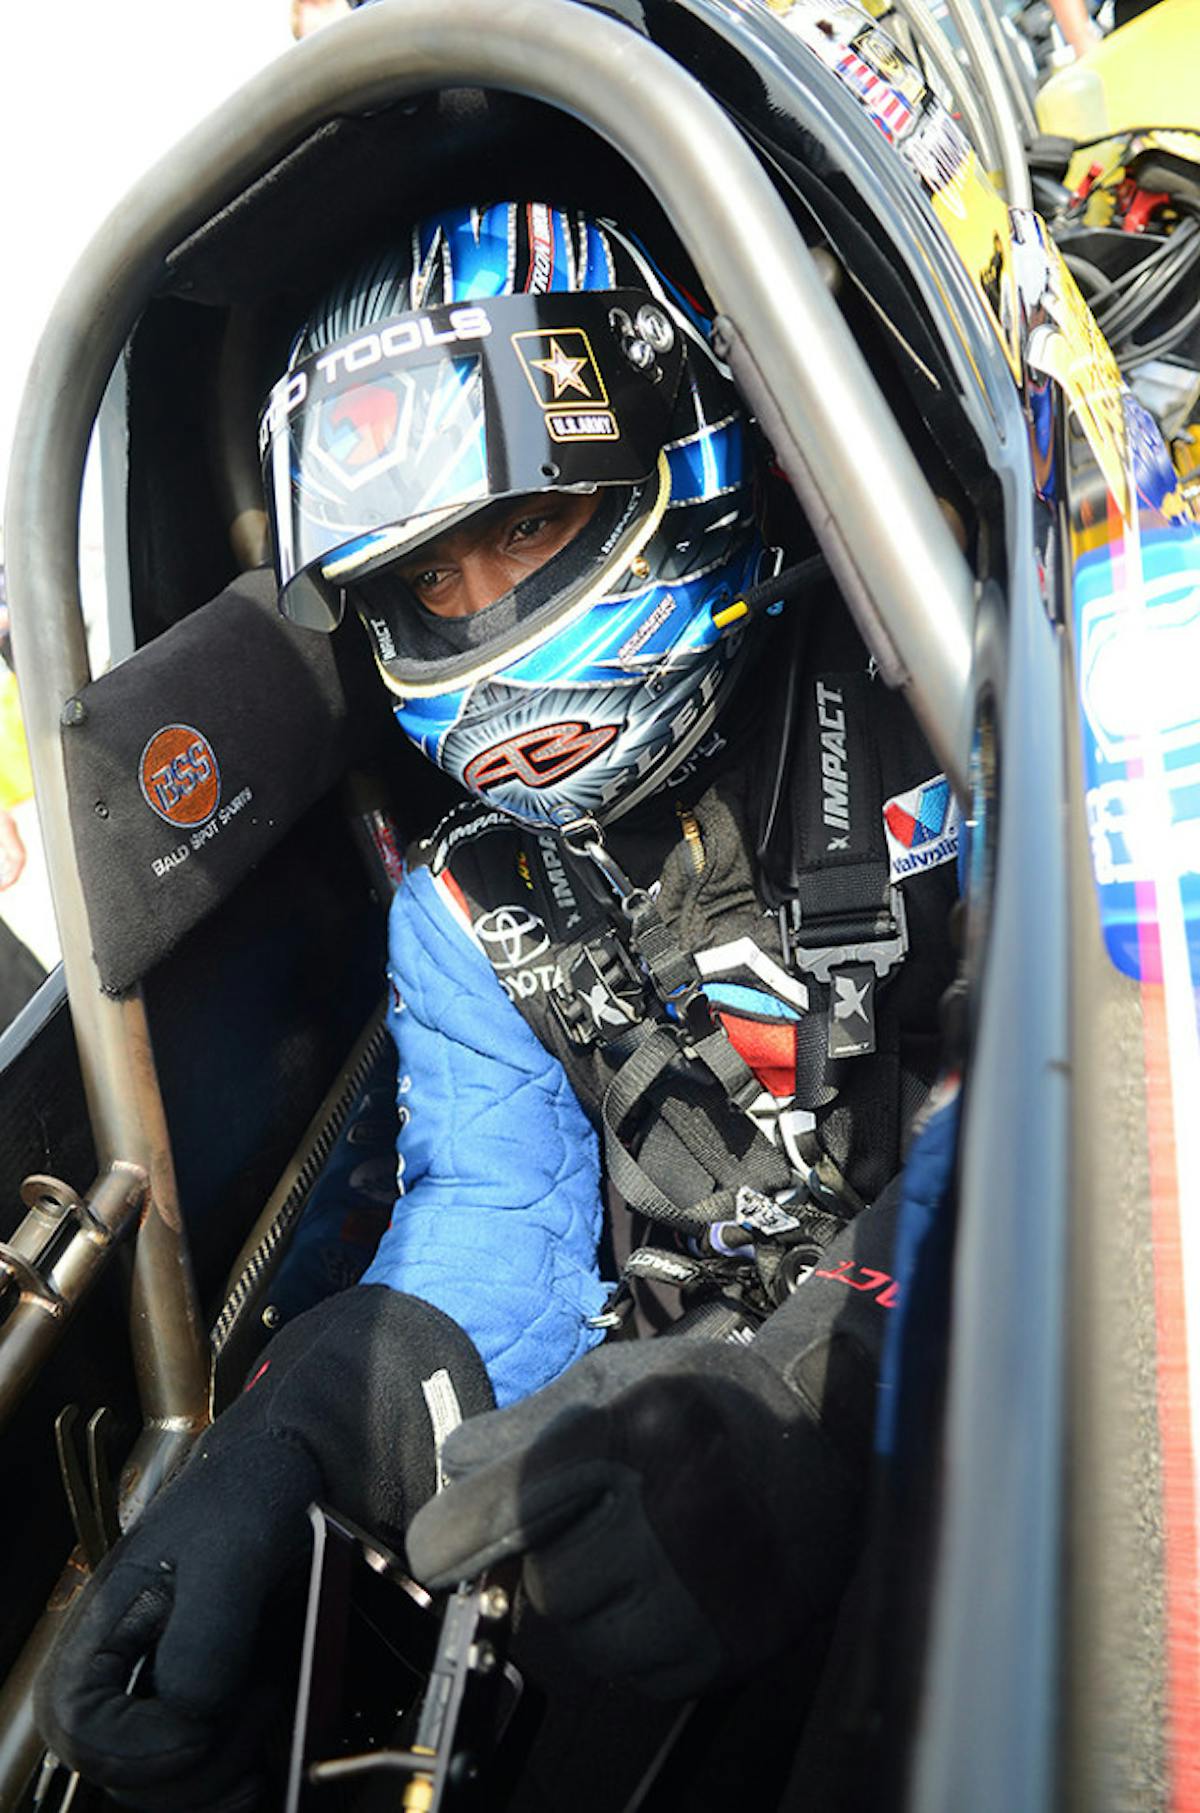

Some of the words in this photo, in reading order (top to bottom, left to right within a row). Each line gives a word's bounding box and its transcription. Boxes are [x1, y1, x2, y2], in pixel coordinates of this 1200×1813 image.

[316, 308, 493, 384] TOOLS
[151, 739, 213, 812] BSS
[816, 681, 849, 830] IMPACT
[151, 844, 190, 877] BALD
